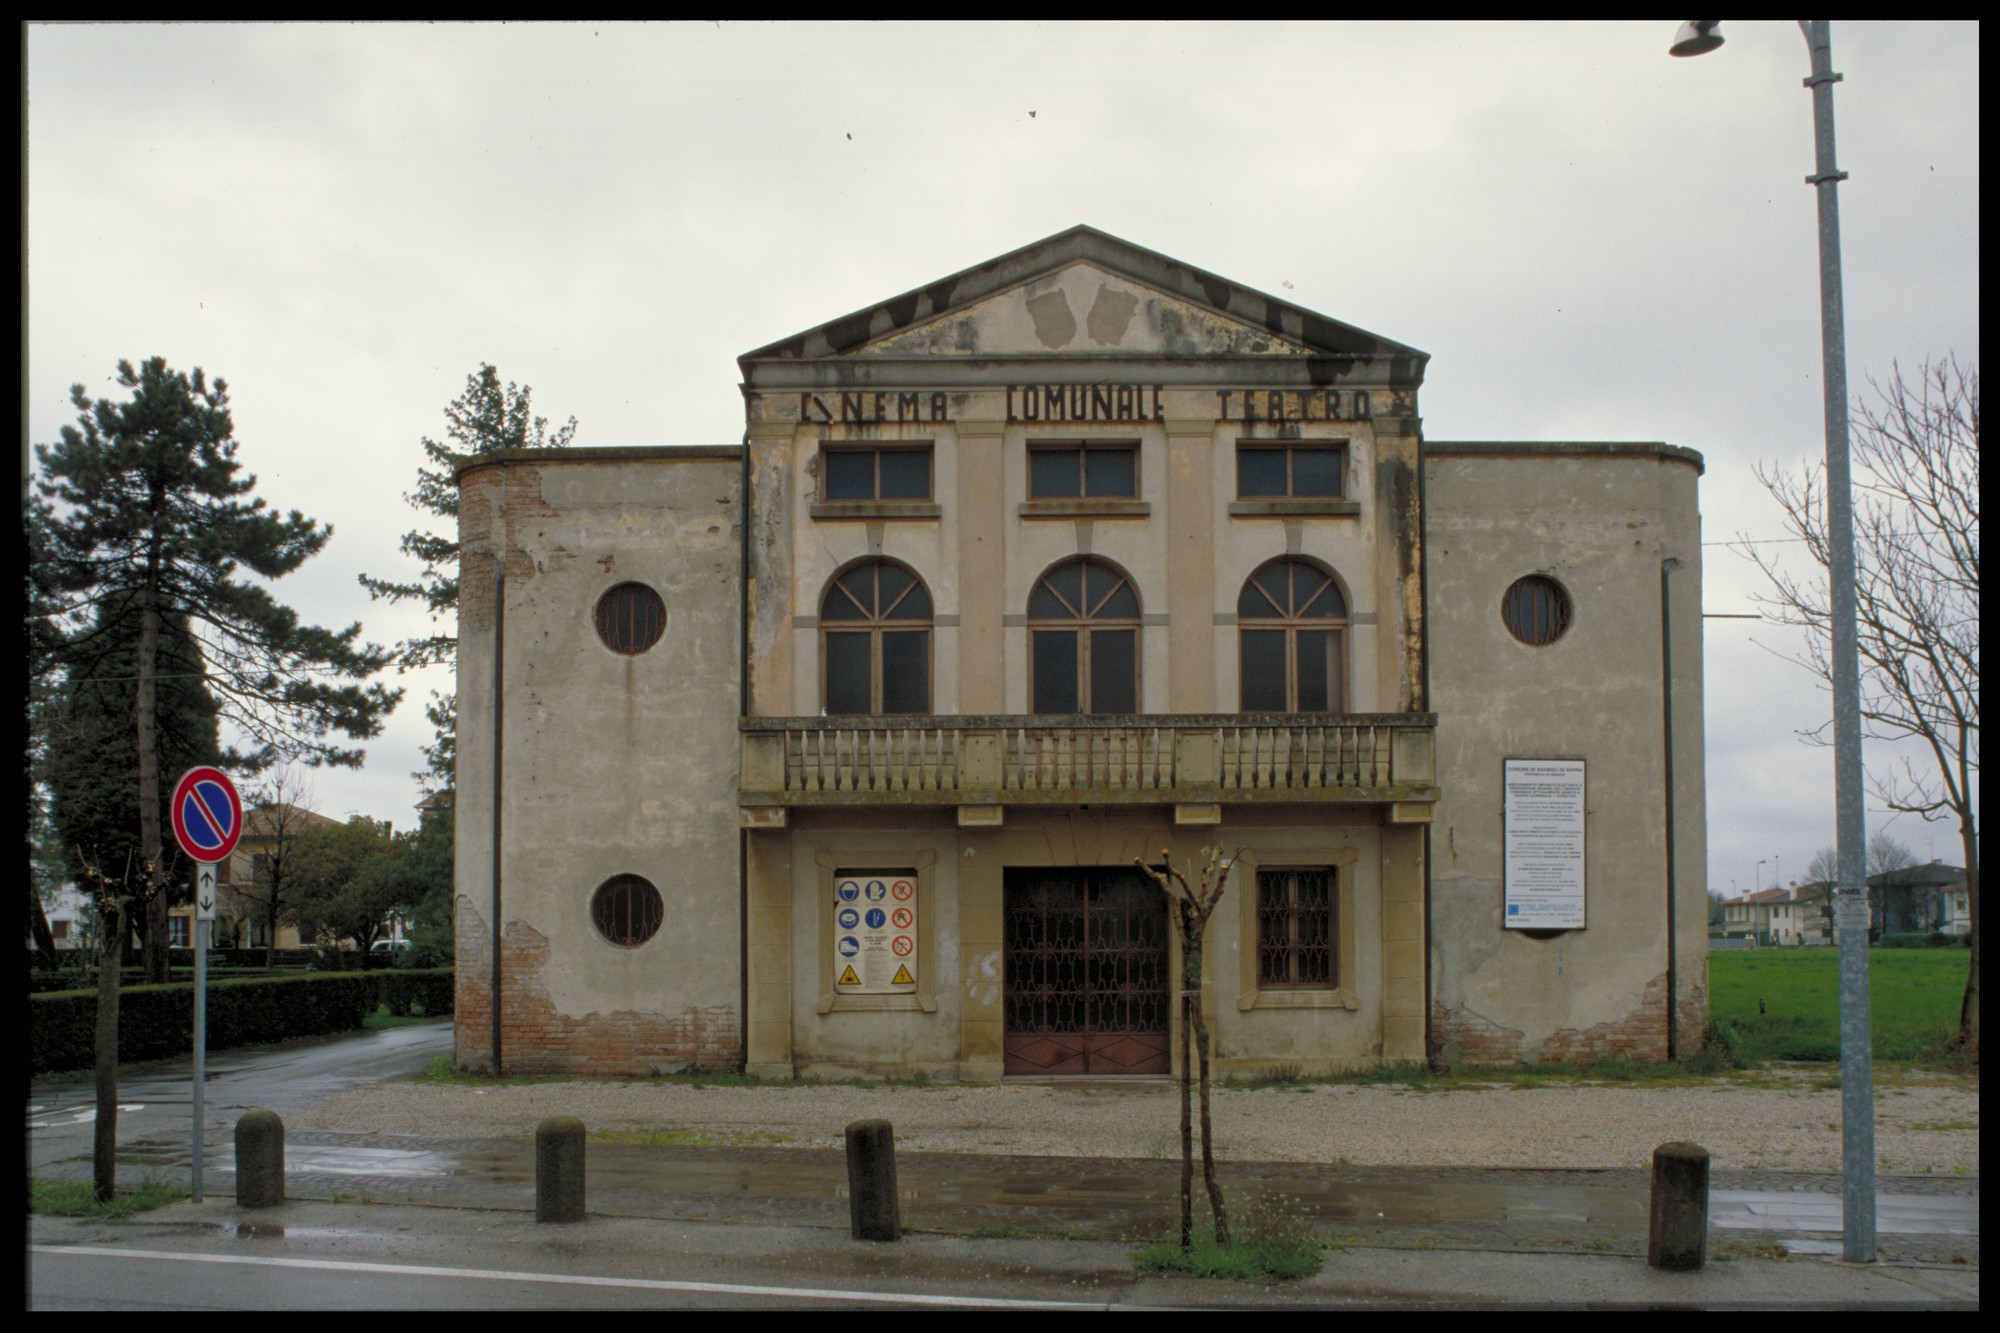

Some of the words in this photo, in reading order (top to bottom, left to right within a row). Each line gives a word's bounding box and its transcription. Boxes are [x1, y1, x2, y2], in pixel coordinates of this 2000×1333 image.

[801, 391, 947, 422] CINEMA
[1006, 384, 1164, 421] COMUNALE
[1216, 389, 1370, 420] TEATRO
